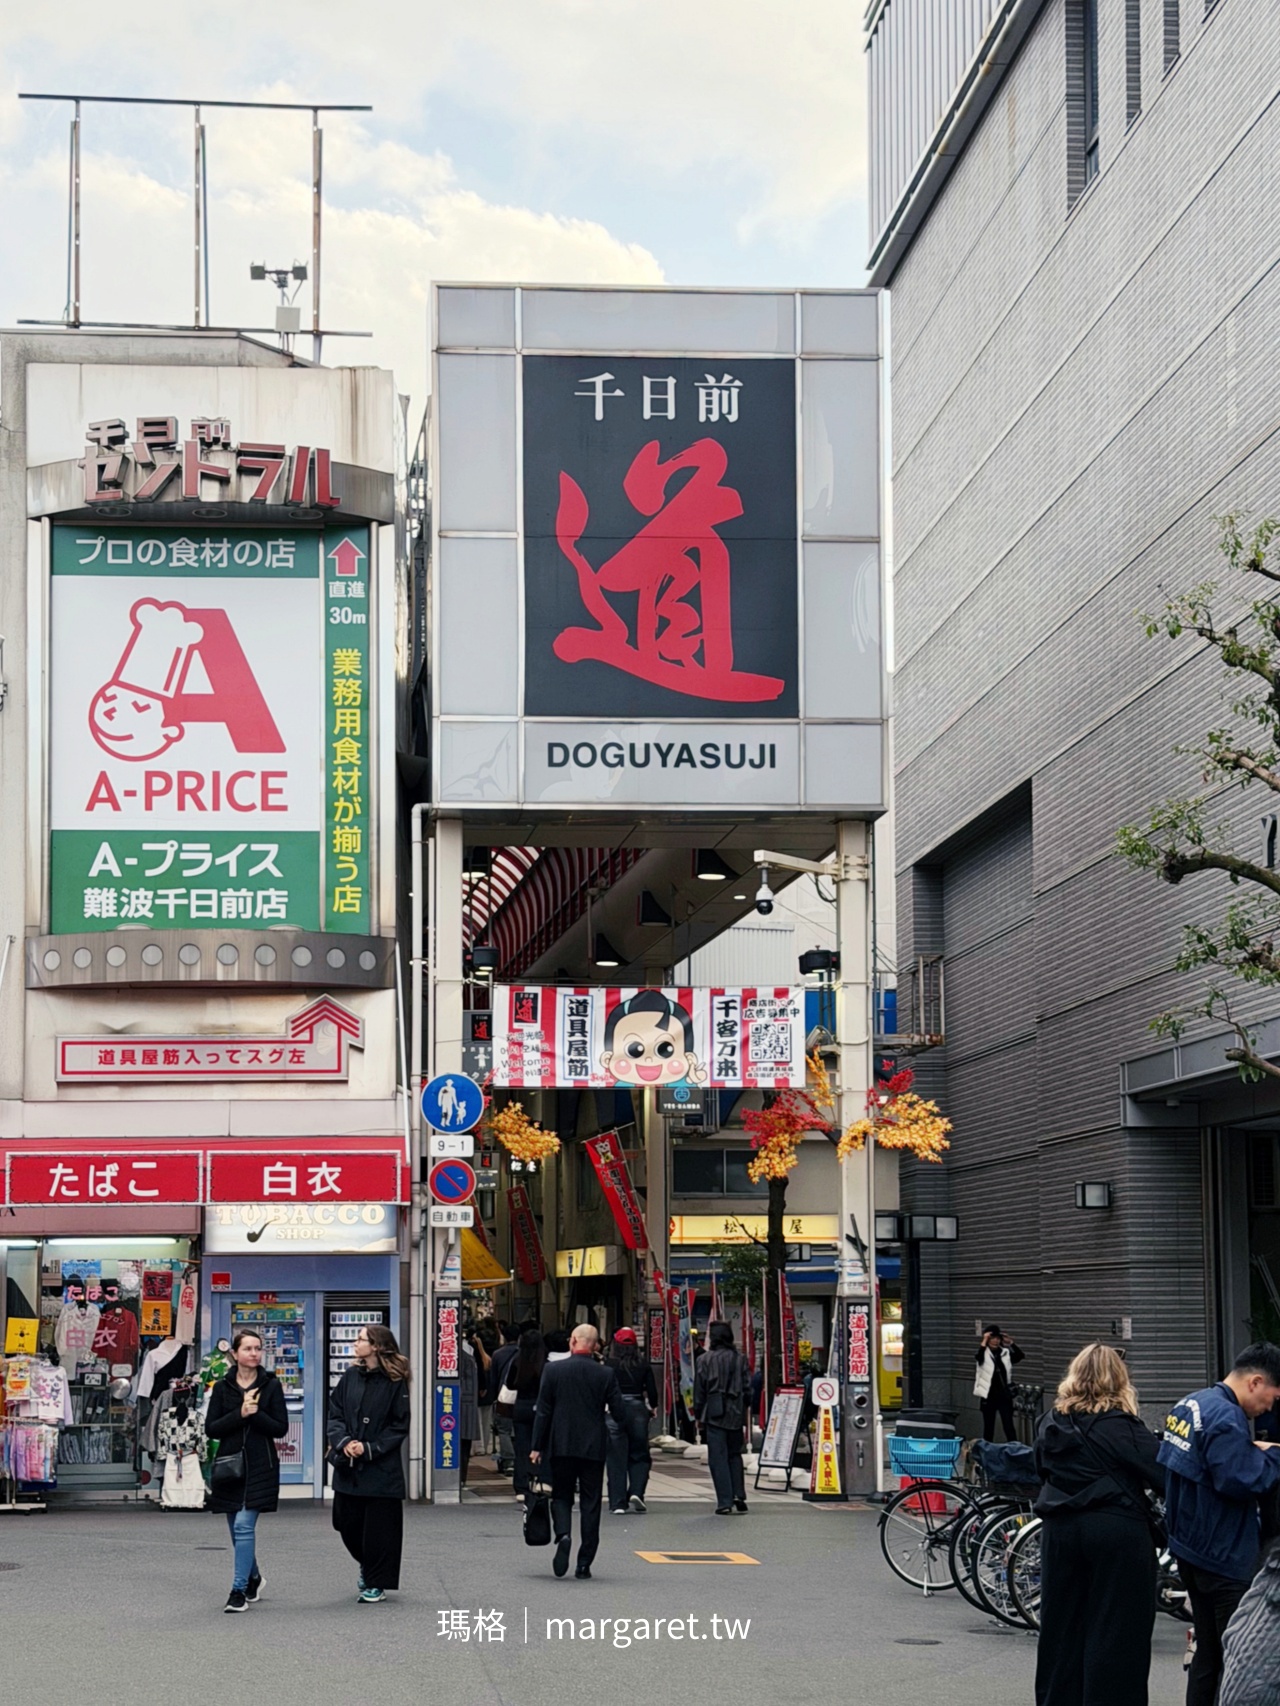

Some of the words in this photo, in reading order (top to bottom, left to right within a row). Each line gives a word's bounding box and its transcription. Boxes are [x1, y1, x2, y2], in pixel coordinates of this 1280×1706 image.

[574, 371, 744, 423] 千日前
[85, 416, 232, 449] 千日前
[78, 440, 342, 510] セントラル
[75, 536, 297, 569] プロの食材の店
[552, 437, 785, 702] 道
[328, 581, 366, 599] 直進
[329, 606, 367, 625] 30m
[547, 742, 777, 770] DOGUYASUJI
[85, 770, 288, 813] A-PRICE
[332, 648, 363, 914] 業務用食材が揃う店
[88, 840, 284, 878] A-プライス
[83, 888, 289, 919] 難波千日前店
[567, 998, 590, 1077] 道具屋筋
[716, 999, 739, 1077] 千客万来
[98, 1047, 306, 1066] 道具屋筋入ってスグ左
[501, 1058, 550, 1069] Welcome
[48, 1162, 160, 1198] たばこ
[263, 1162, 342, 1196] 白衣
[216, 1204, 386, 1226] TOBACCO
[433, 1211, 471, 1222] 自動車
[276, 1228, 325, 1241] SHOP
[66, 1284, 119, 1301] たばこ
[66, 1326, 118, 1348] 白衣
[438, 1308, 458, 1370] 道具屋筋
[849, 1314, 869, 1375] 道具屋筋
